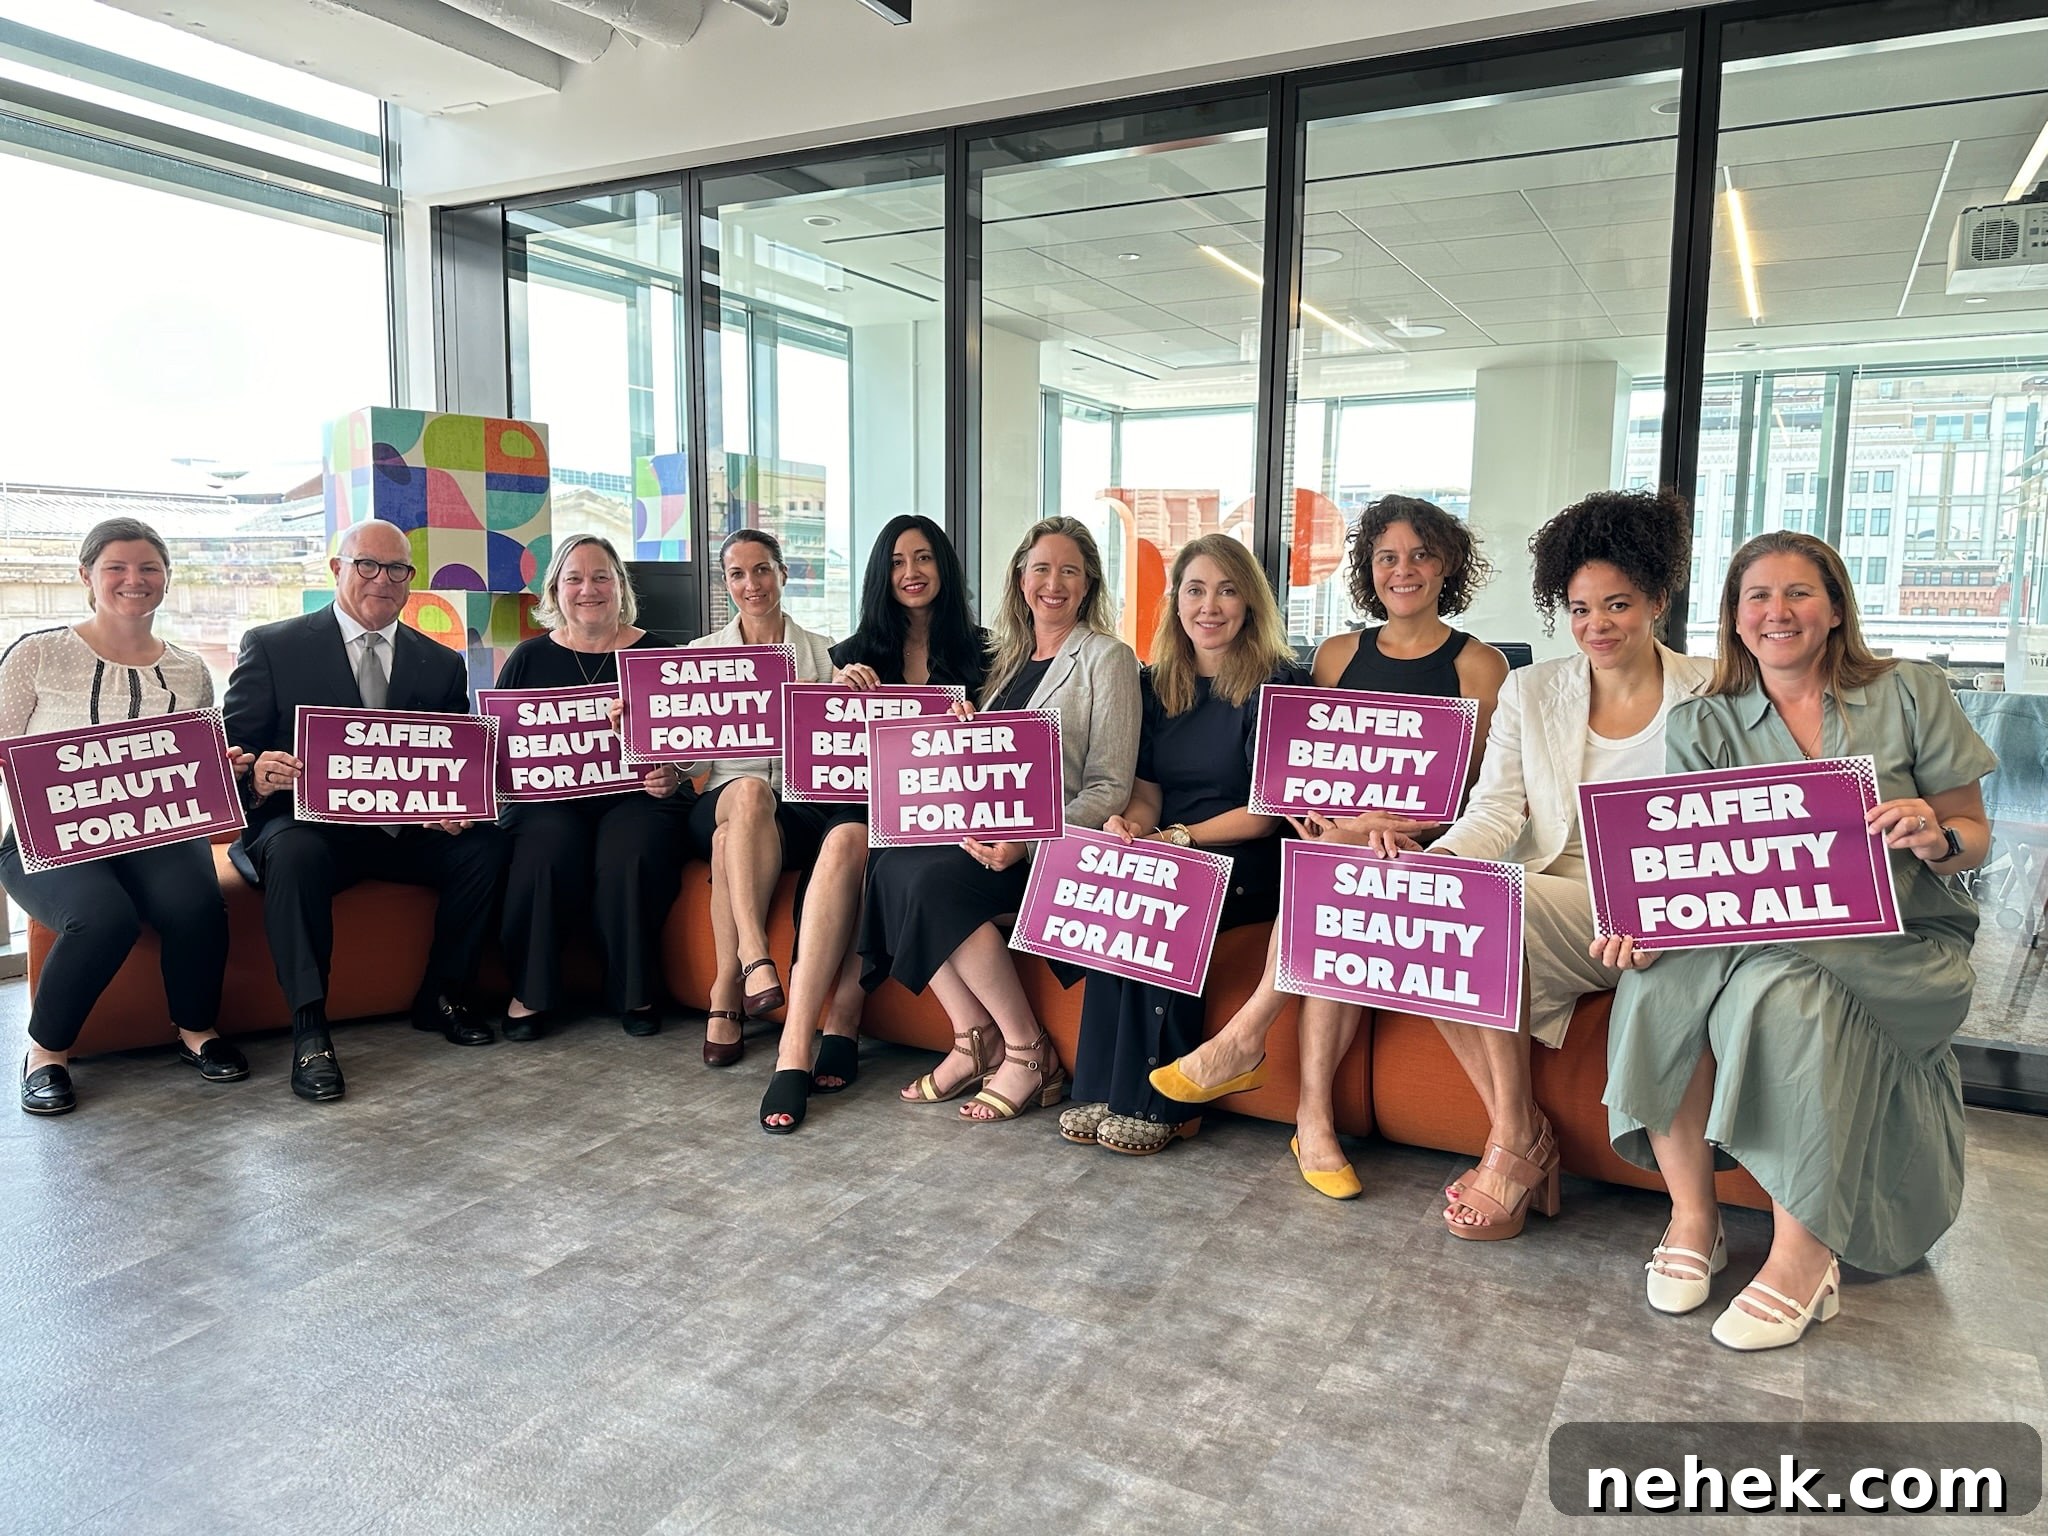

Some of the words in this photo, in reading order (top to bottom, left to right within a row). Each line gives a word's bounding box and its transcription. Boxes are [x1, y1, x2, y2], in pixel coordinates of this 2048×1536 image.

[660, 659, 758, 685] SAFER
[649, 690, 772, 718] BEAUTY
[1307, 703, 1423, 738] SAFER
[56, 729, 181, 772] SAFER
[344, 722, 453, 748] SAFER
[651, 726, 714, 751] FOR
[716, 723, 774, 748] ALL
[812, 731, 867, 756] BEA
[911, 726, 1016, 757] SAFER
[328, 755, 467, 781] BEAUTY
[512, 765, 577, 790] FOR
[580, 760, 638, 786] ALL
[1288, 740, 1438, 775] BEAUTY
[46, 761, 200, 814] BEAUTY
[898, 763, 1033, 796] BEAUTY
[1283, 777, 1354, 806] FOR
[1353, 783, 1426, 811] ALL
[328, 788, 401, 812] FOR
[403, 790, 467, 812] ALL
[899, 802, 966, 832] FOR
[969, 800, 1034, 829] ALL
[1647, 784, 1811, 831] SAFER
[55, 811, 139, 851] FOR
[144, 799, 212, 834] ALL
[1076, 843, 1179, 890] SAFER
[1631, 831, 1837, 882] BEAUTY
[1053, 877, 1189, 931] BEAUTY
[1333, 863, 1465, 910] SAFER
[1638, 891, 1747, 932] FOR
[1750, 884, 1850, 924] ALL
[1042, 915, 1107, 954] FOR
[1100, 932, 1174, 973] ALL
[1315, 904, 1485, 958] BEAUTY
[1313, 948, 1396, 991] FOR
[1398, 963, 1480, 1006] ALL
